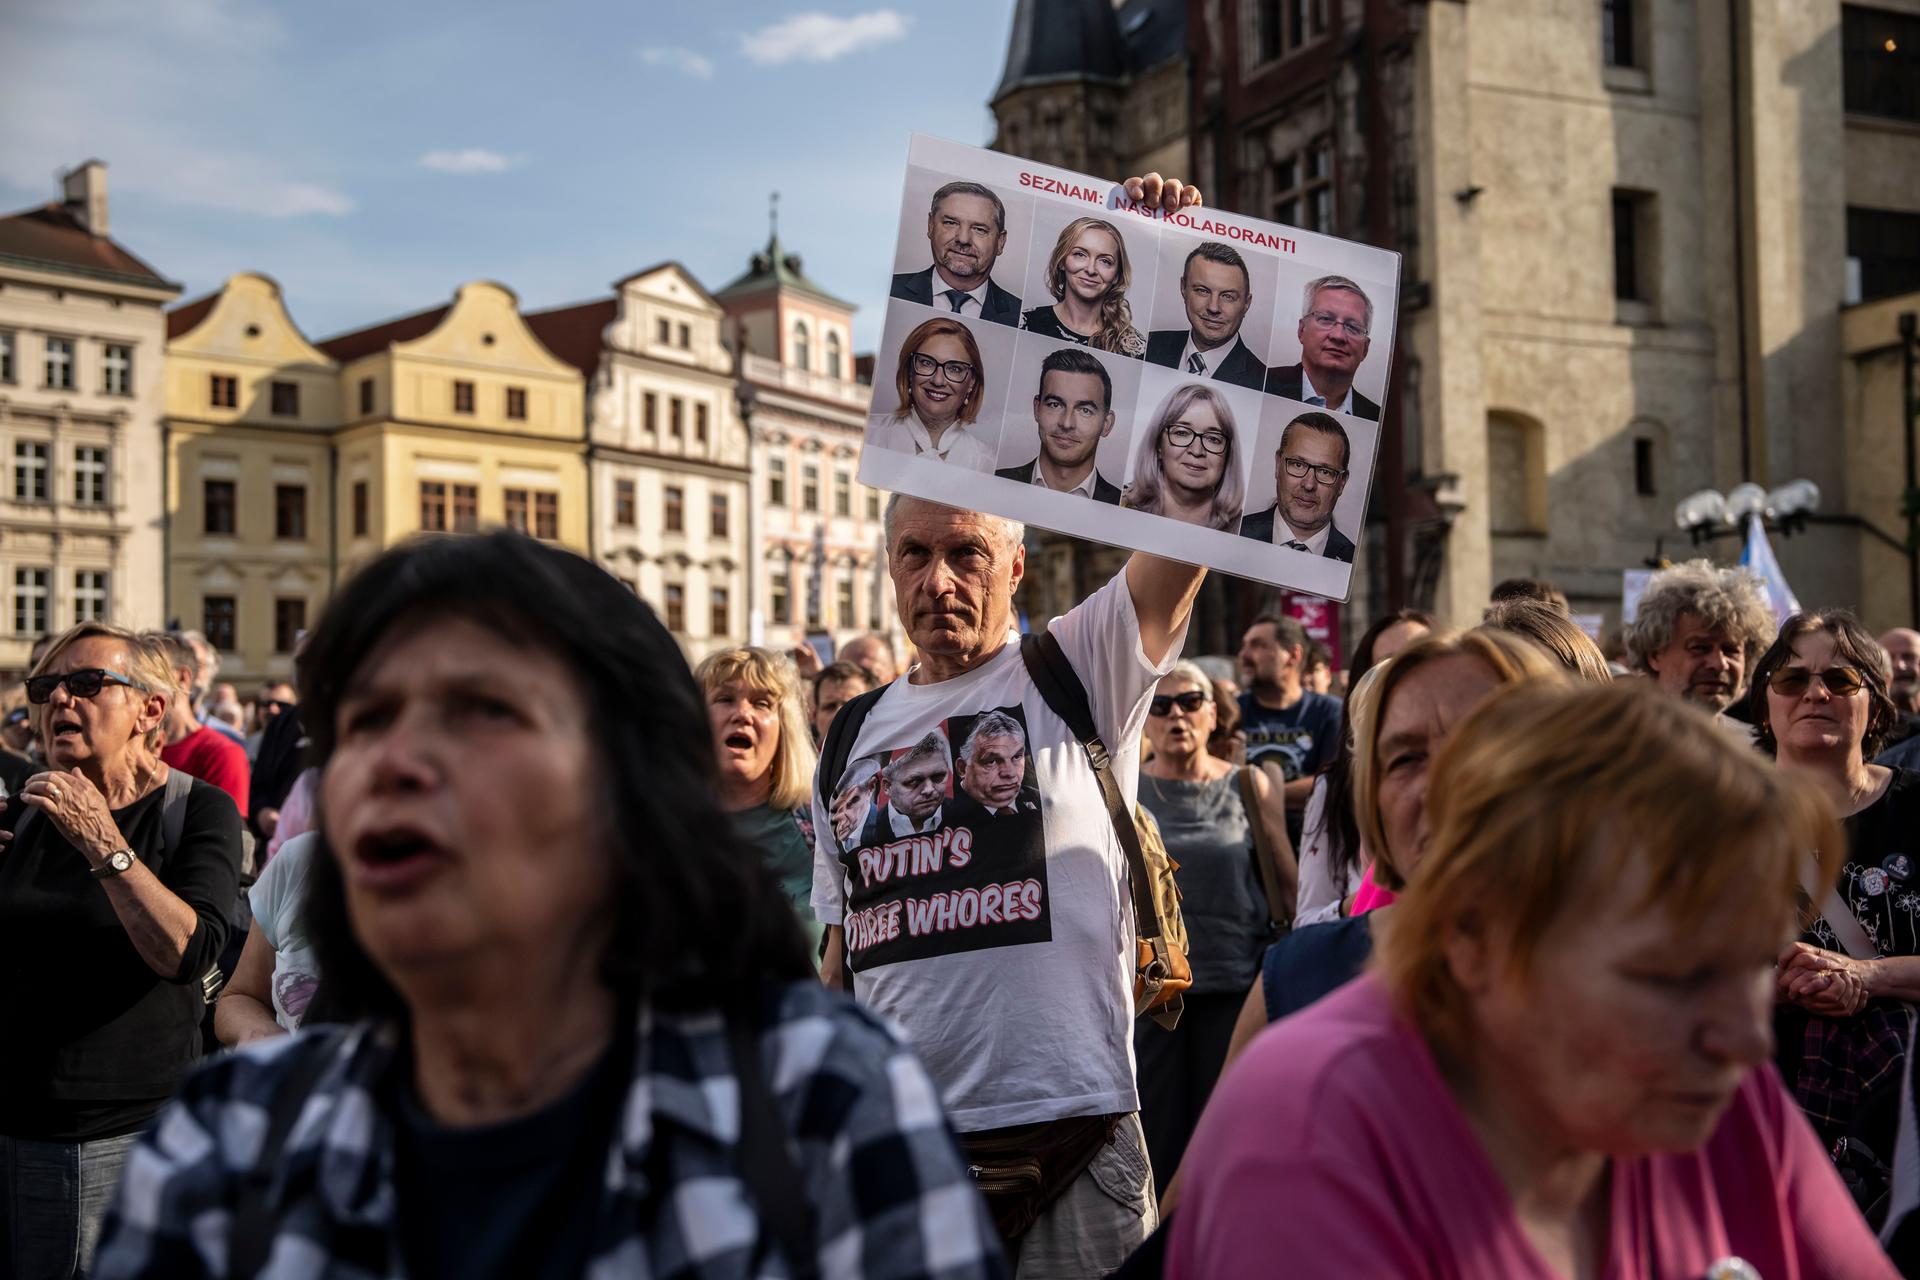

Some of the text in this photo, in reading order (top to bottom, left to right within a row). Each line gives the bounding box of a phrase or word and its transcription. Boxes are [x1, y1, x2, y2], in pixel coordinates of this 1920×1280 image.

[1019, 172, 1103, 205] SEZNAM:
[1163, 210, 1296, 254] KOLABORANTI
[858, 827, 973, 888] PUTIN'S
[848, 878, 1042, 951] THREE WHORES
